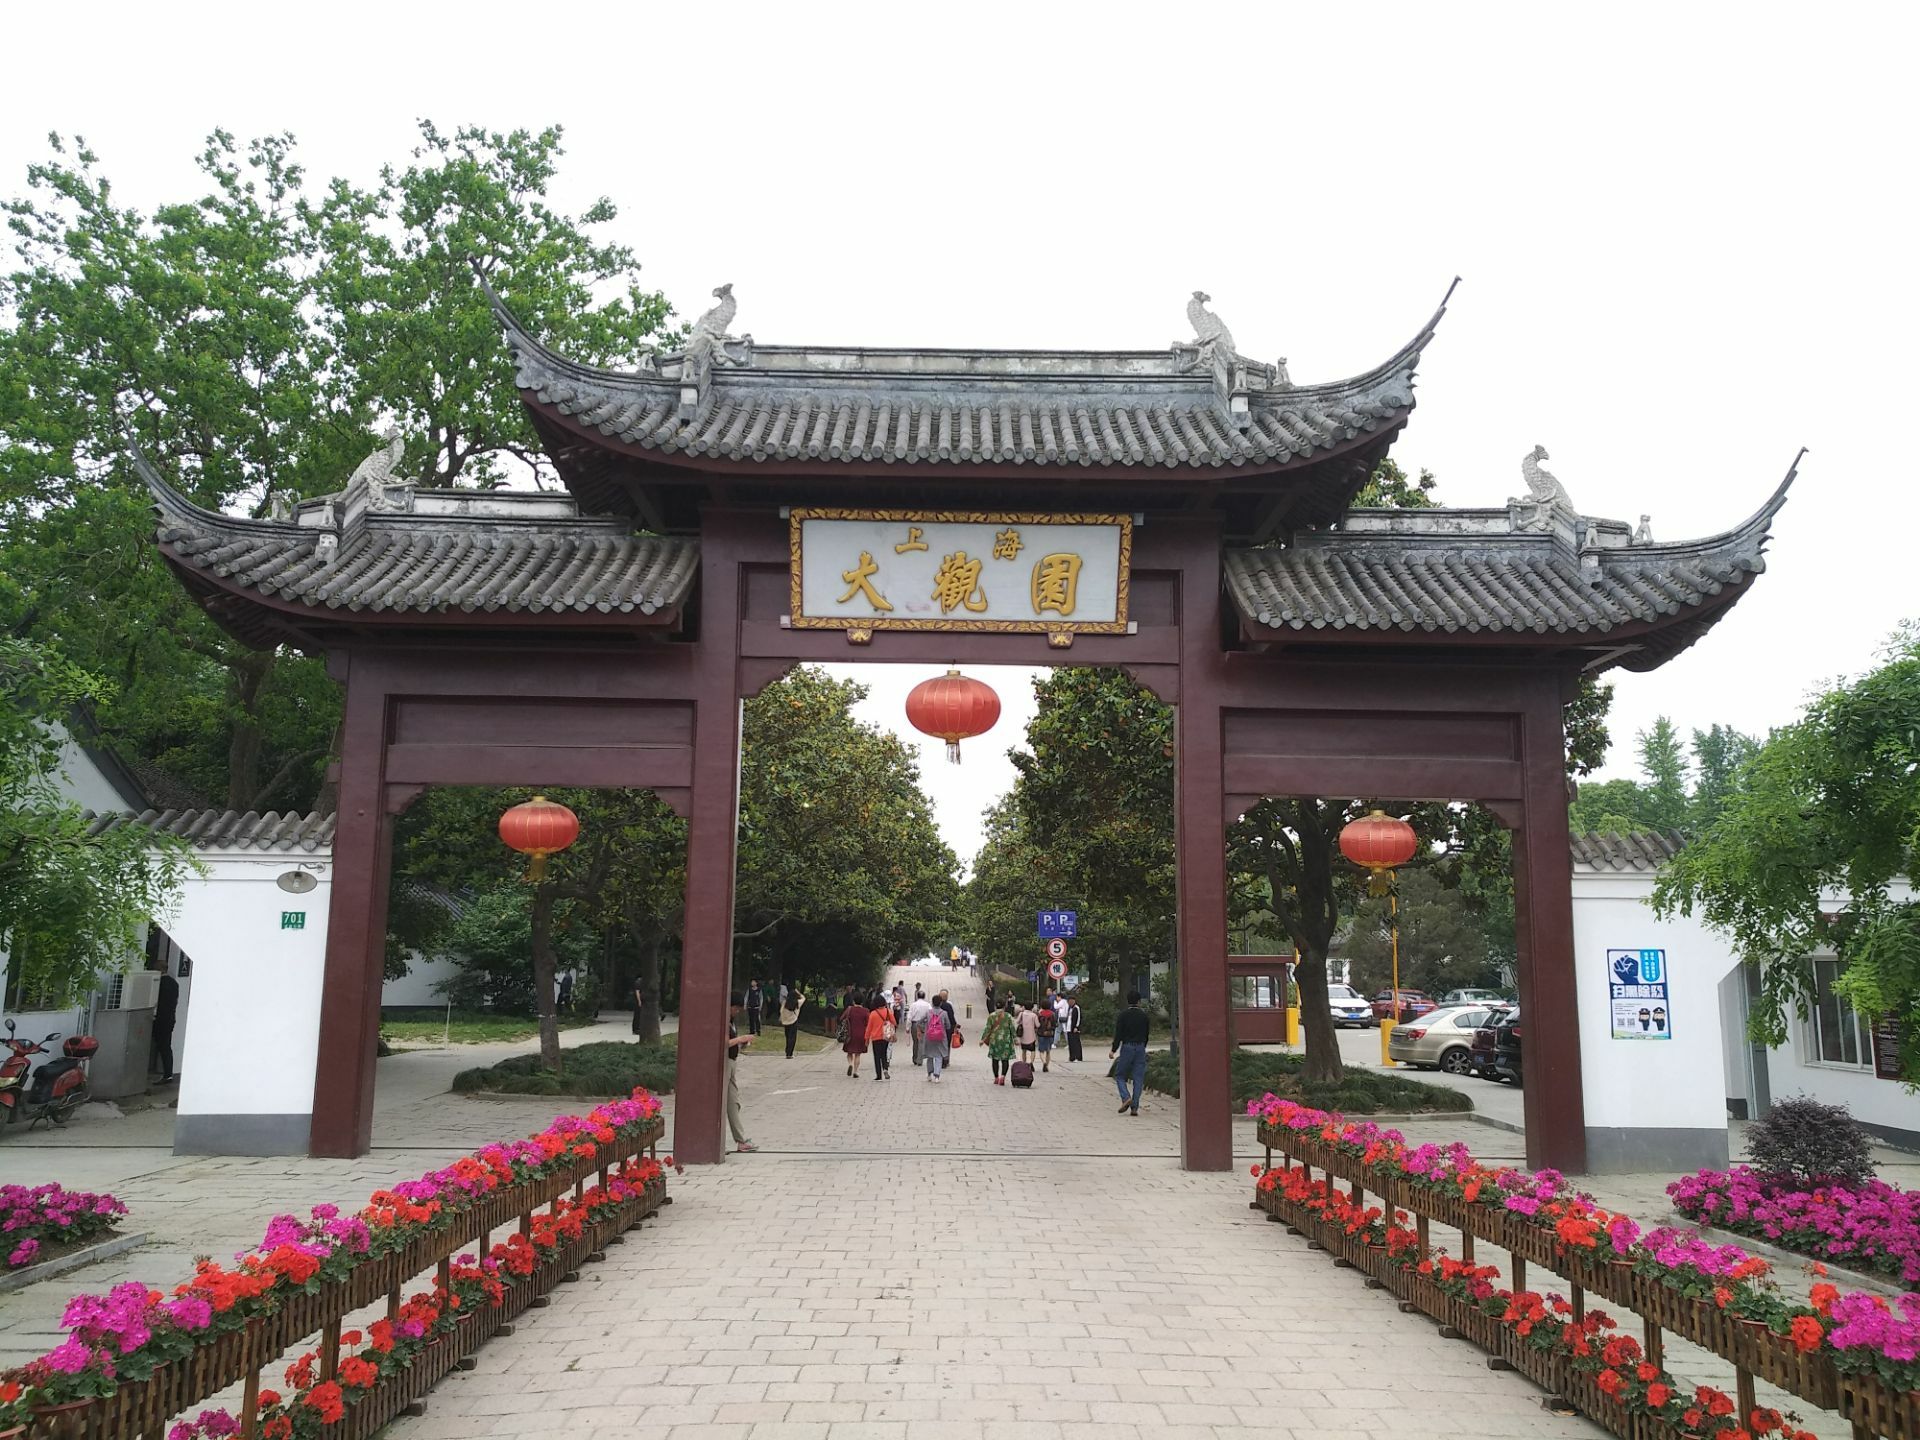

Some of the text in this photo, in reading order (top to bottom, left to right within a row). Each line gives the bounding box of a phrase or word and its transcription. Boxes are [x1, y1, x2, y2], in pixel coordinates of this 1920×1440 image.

[894, 526, 1025, 561] 上海
[836, 551, 1083, 616] 大觀園
[284, 913, 303, 924] 701
[1043, 914, 1068, 926] P P
[1053, 943, 1061, 953] 5
